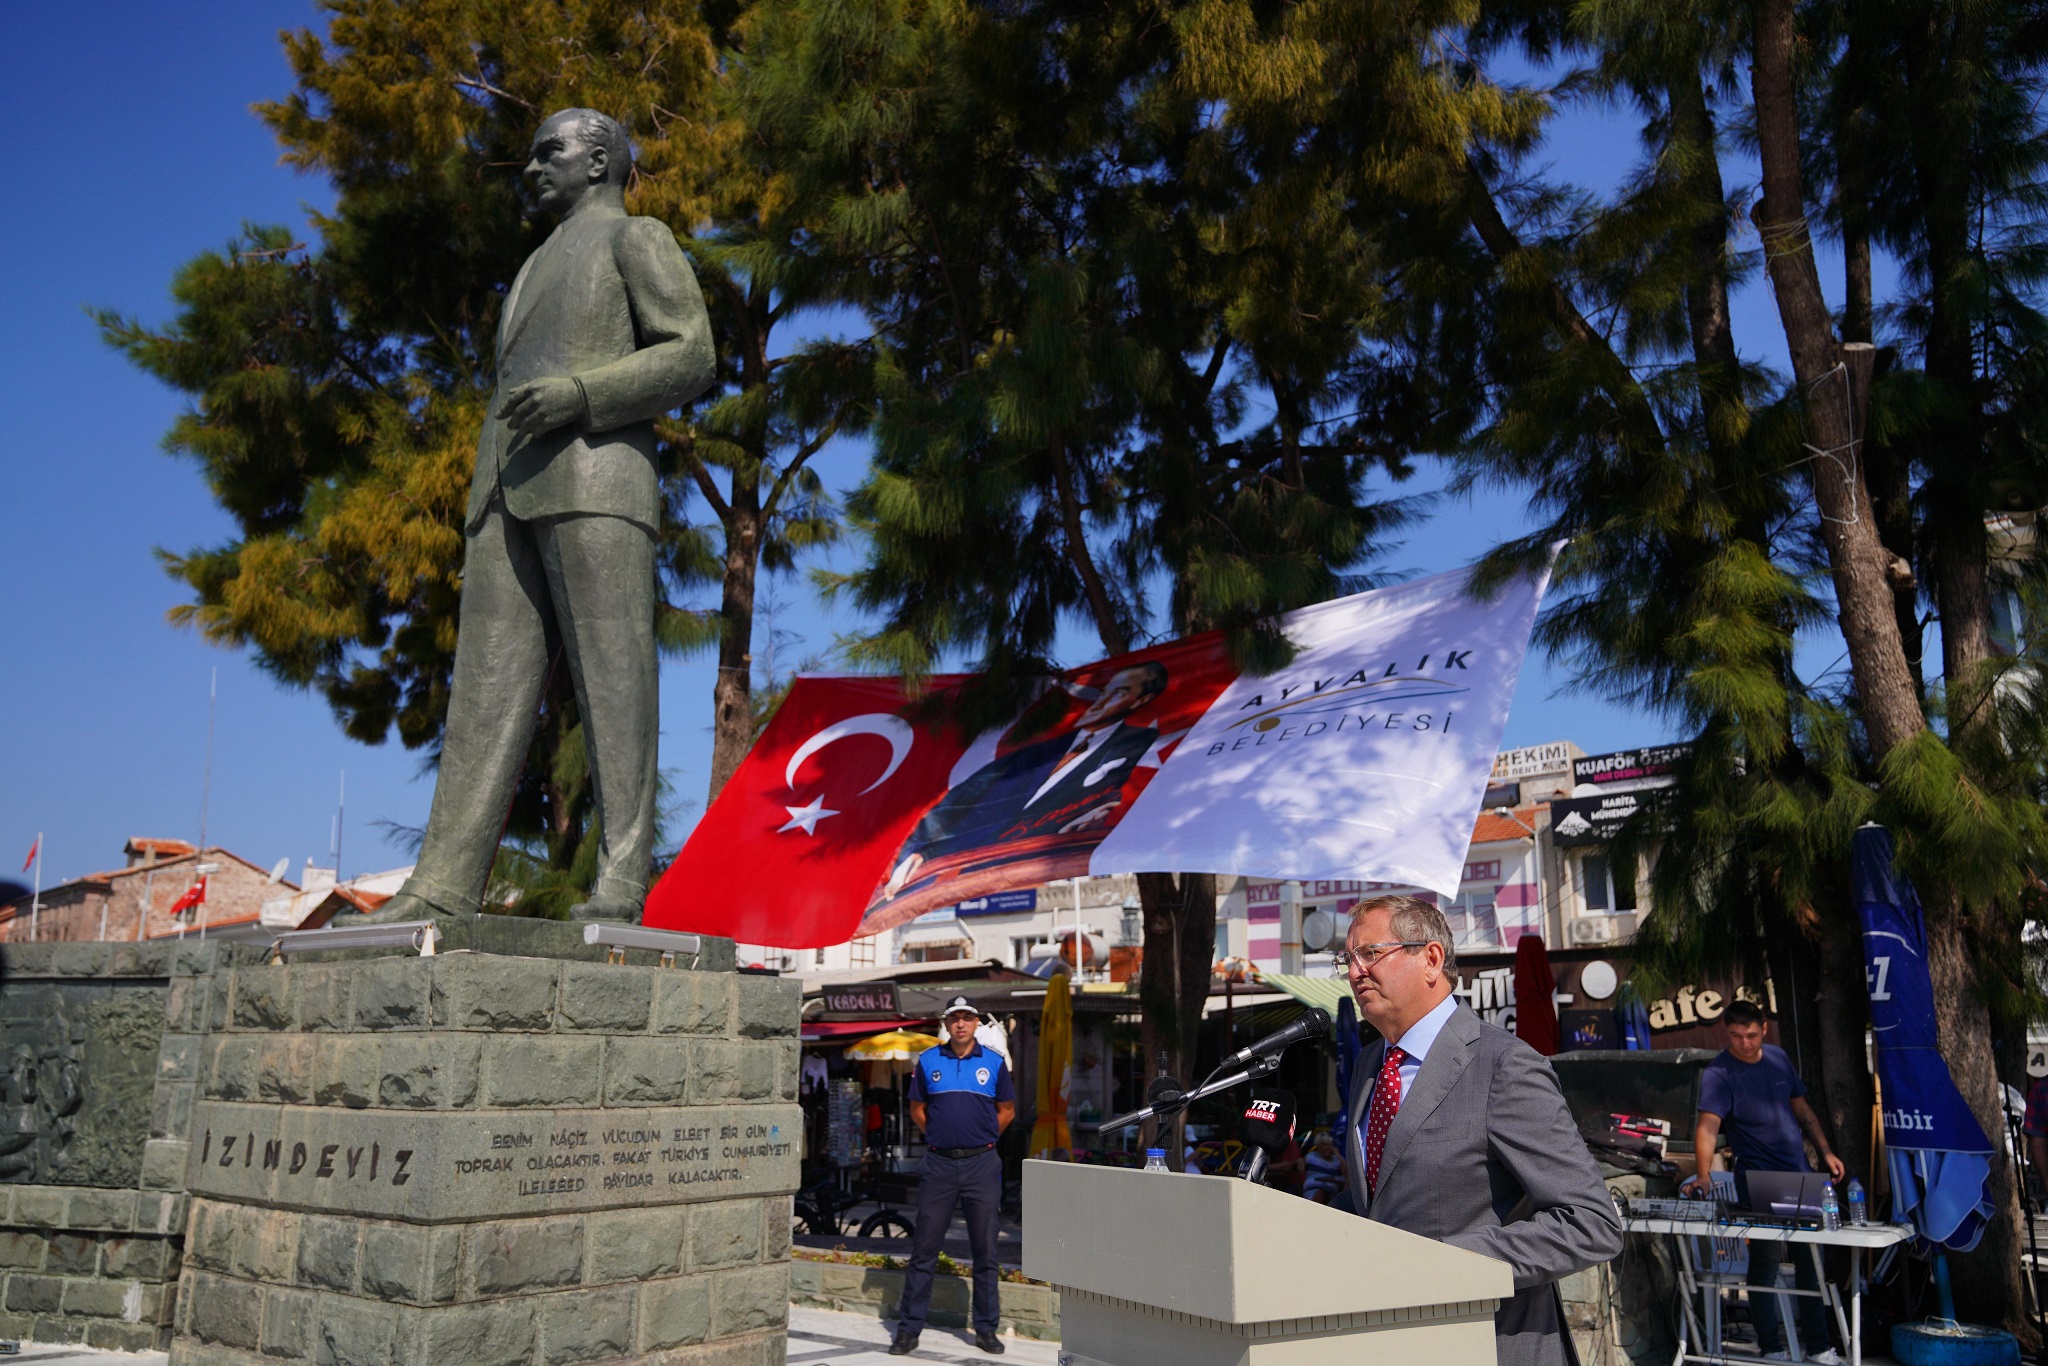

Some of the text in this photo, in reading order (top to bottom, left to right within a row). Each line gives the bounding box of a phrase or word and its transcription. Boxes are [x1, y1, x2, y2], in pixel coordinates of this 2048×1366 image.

[1240, 650, 1473, 710] AYVALIK
[1206, 711, 1452, 756] BELEDİYESİ
[1575, 752, 1636, 776] KUAFÖR
[1649, 984, 1725, 1029] afe
[1245, 1109, 1276, 1121] HABER
[1251, 1099, 1281, 1113] TRT
[491, 1131, 533, 1149] BENİM
[673, 1127, 711, 1142] ELBET
[719, 1124, 739, 1140] BİR
[455, 1157, 514, 1174] TOPRAK
[613, 1151, 651, 1165] FAKAT
[660, 1146, 710, 1163] TÜRKİYE
[668, 1167, 742, 1185] KALACAKTIR.
